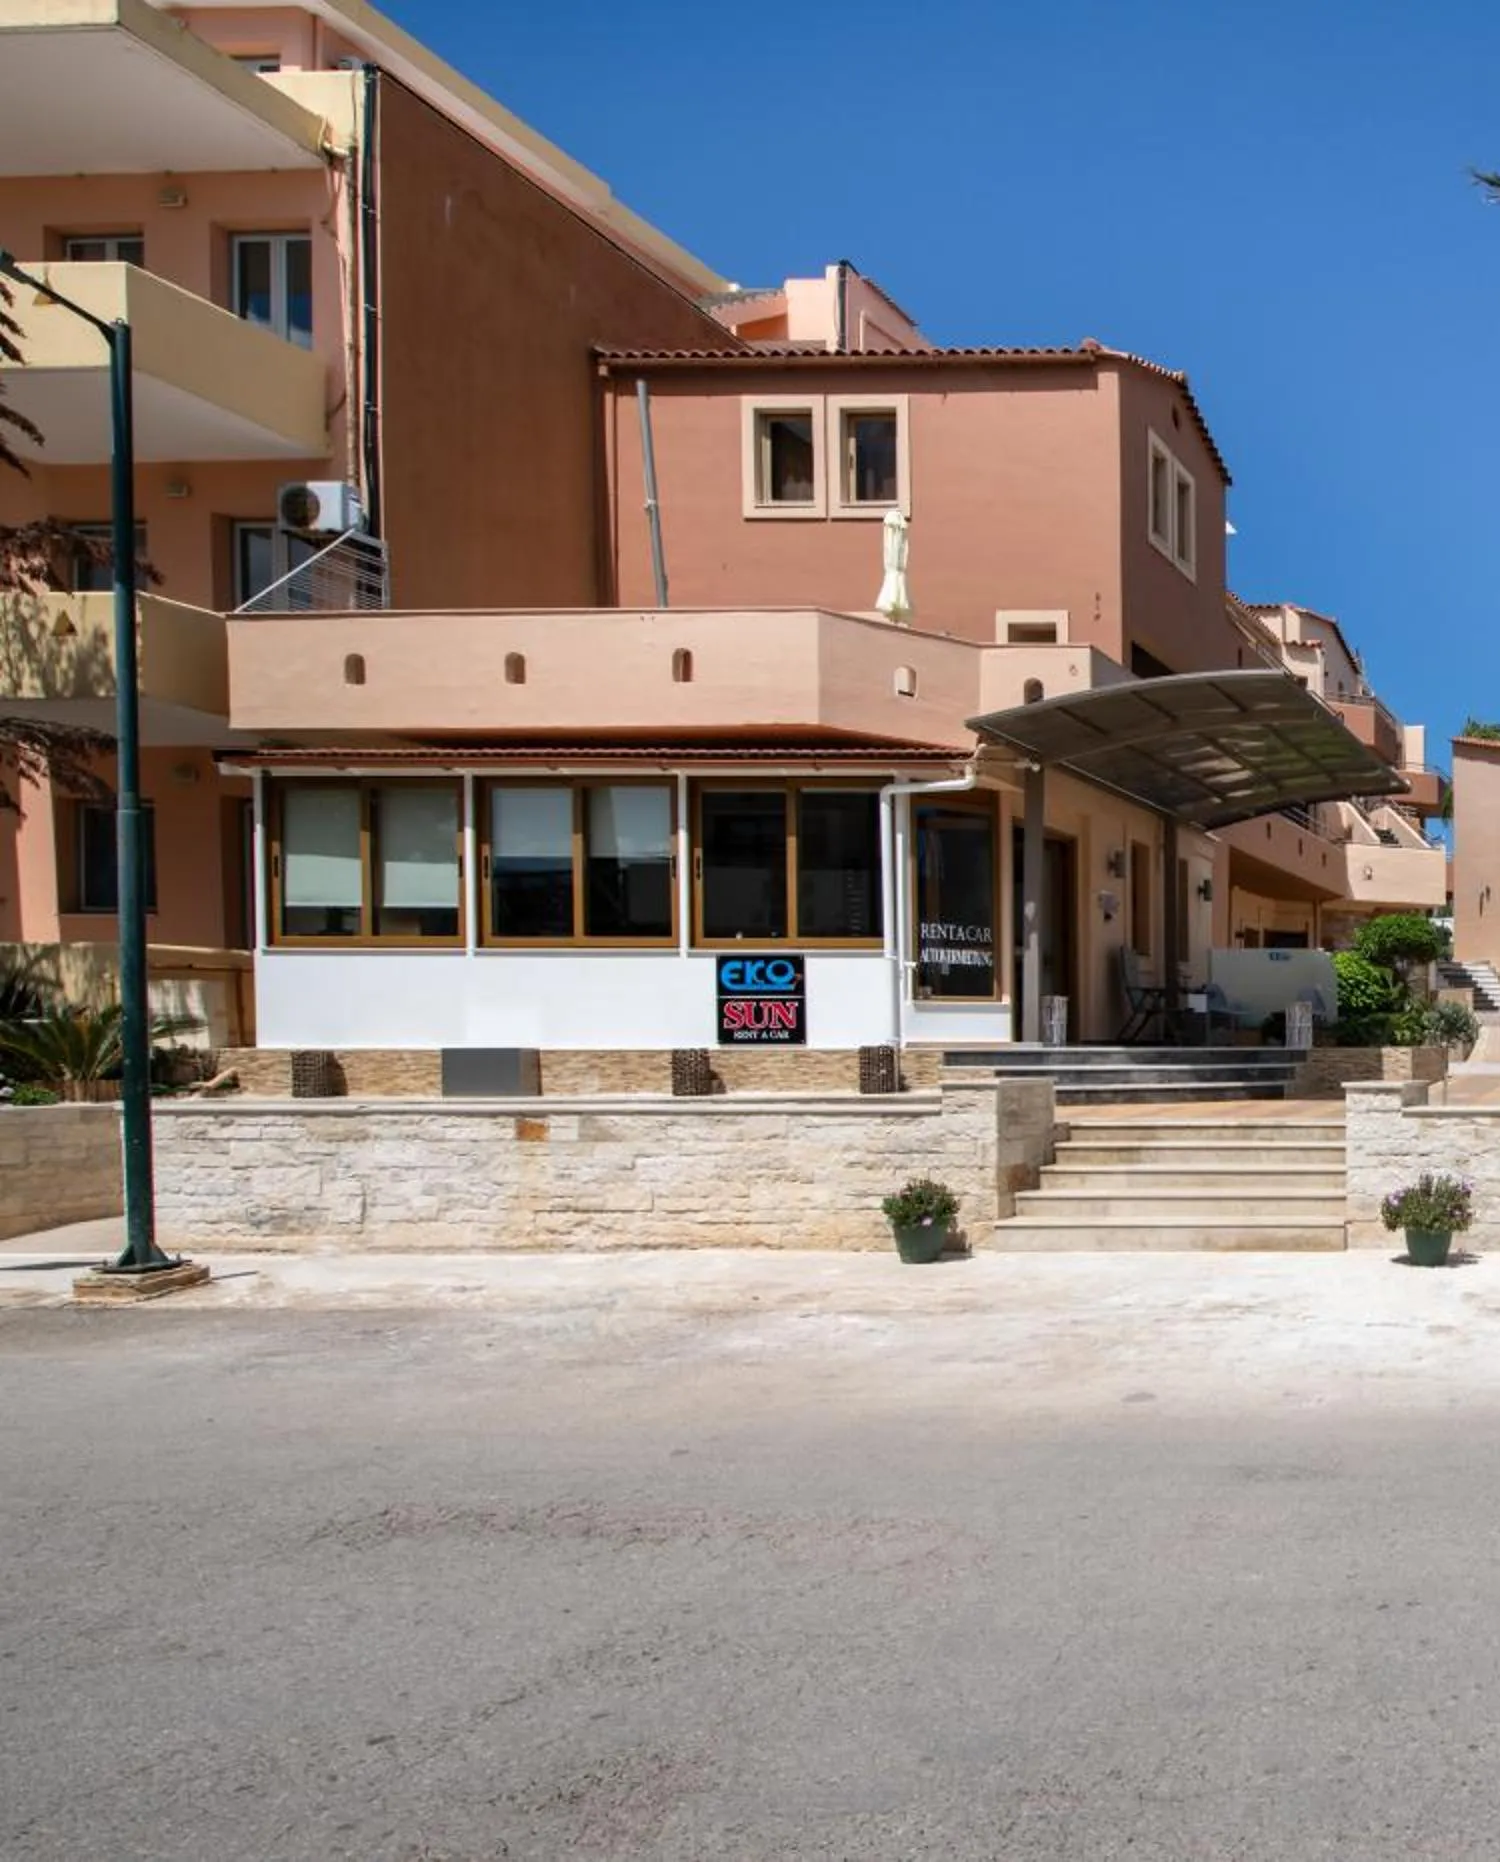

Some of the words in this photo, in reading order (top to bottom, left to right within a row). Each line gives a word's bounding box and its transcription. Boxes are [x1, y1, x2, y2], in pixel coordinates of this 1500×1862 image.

[721, 960, 795, 990] EKO
[723, 1001, 798, 1029] SUN
[733, 1030, 757, 1039] RENT
[761, 1030, 768, 1039] A
[769, 1030, 789, 1039] CAR
